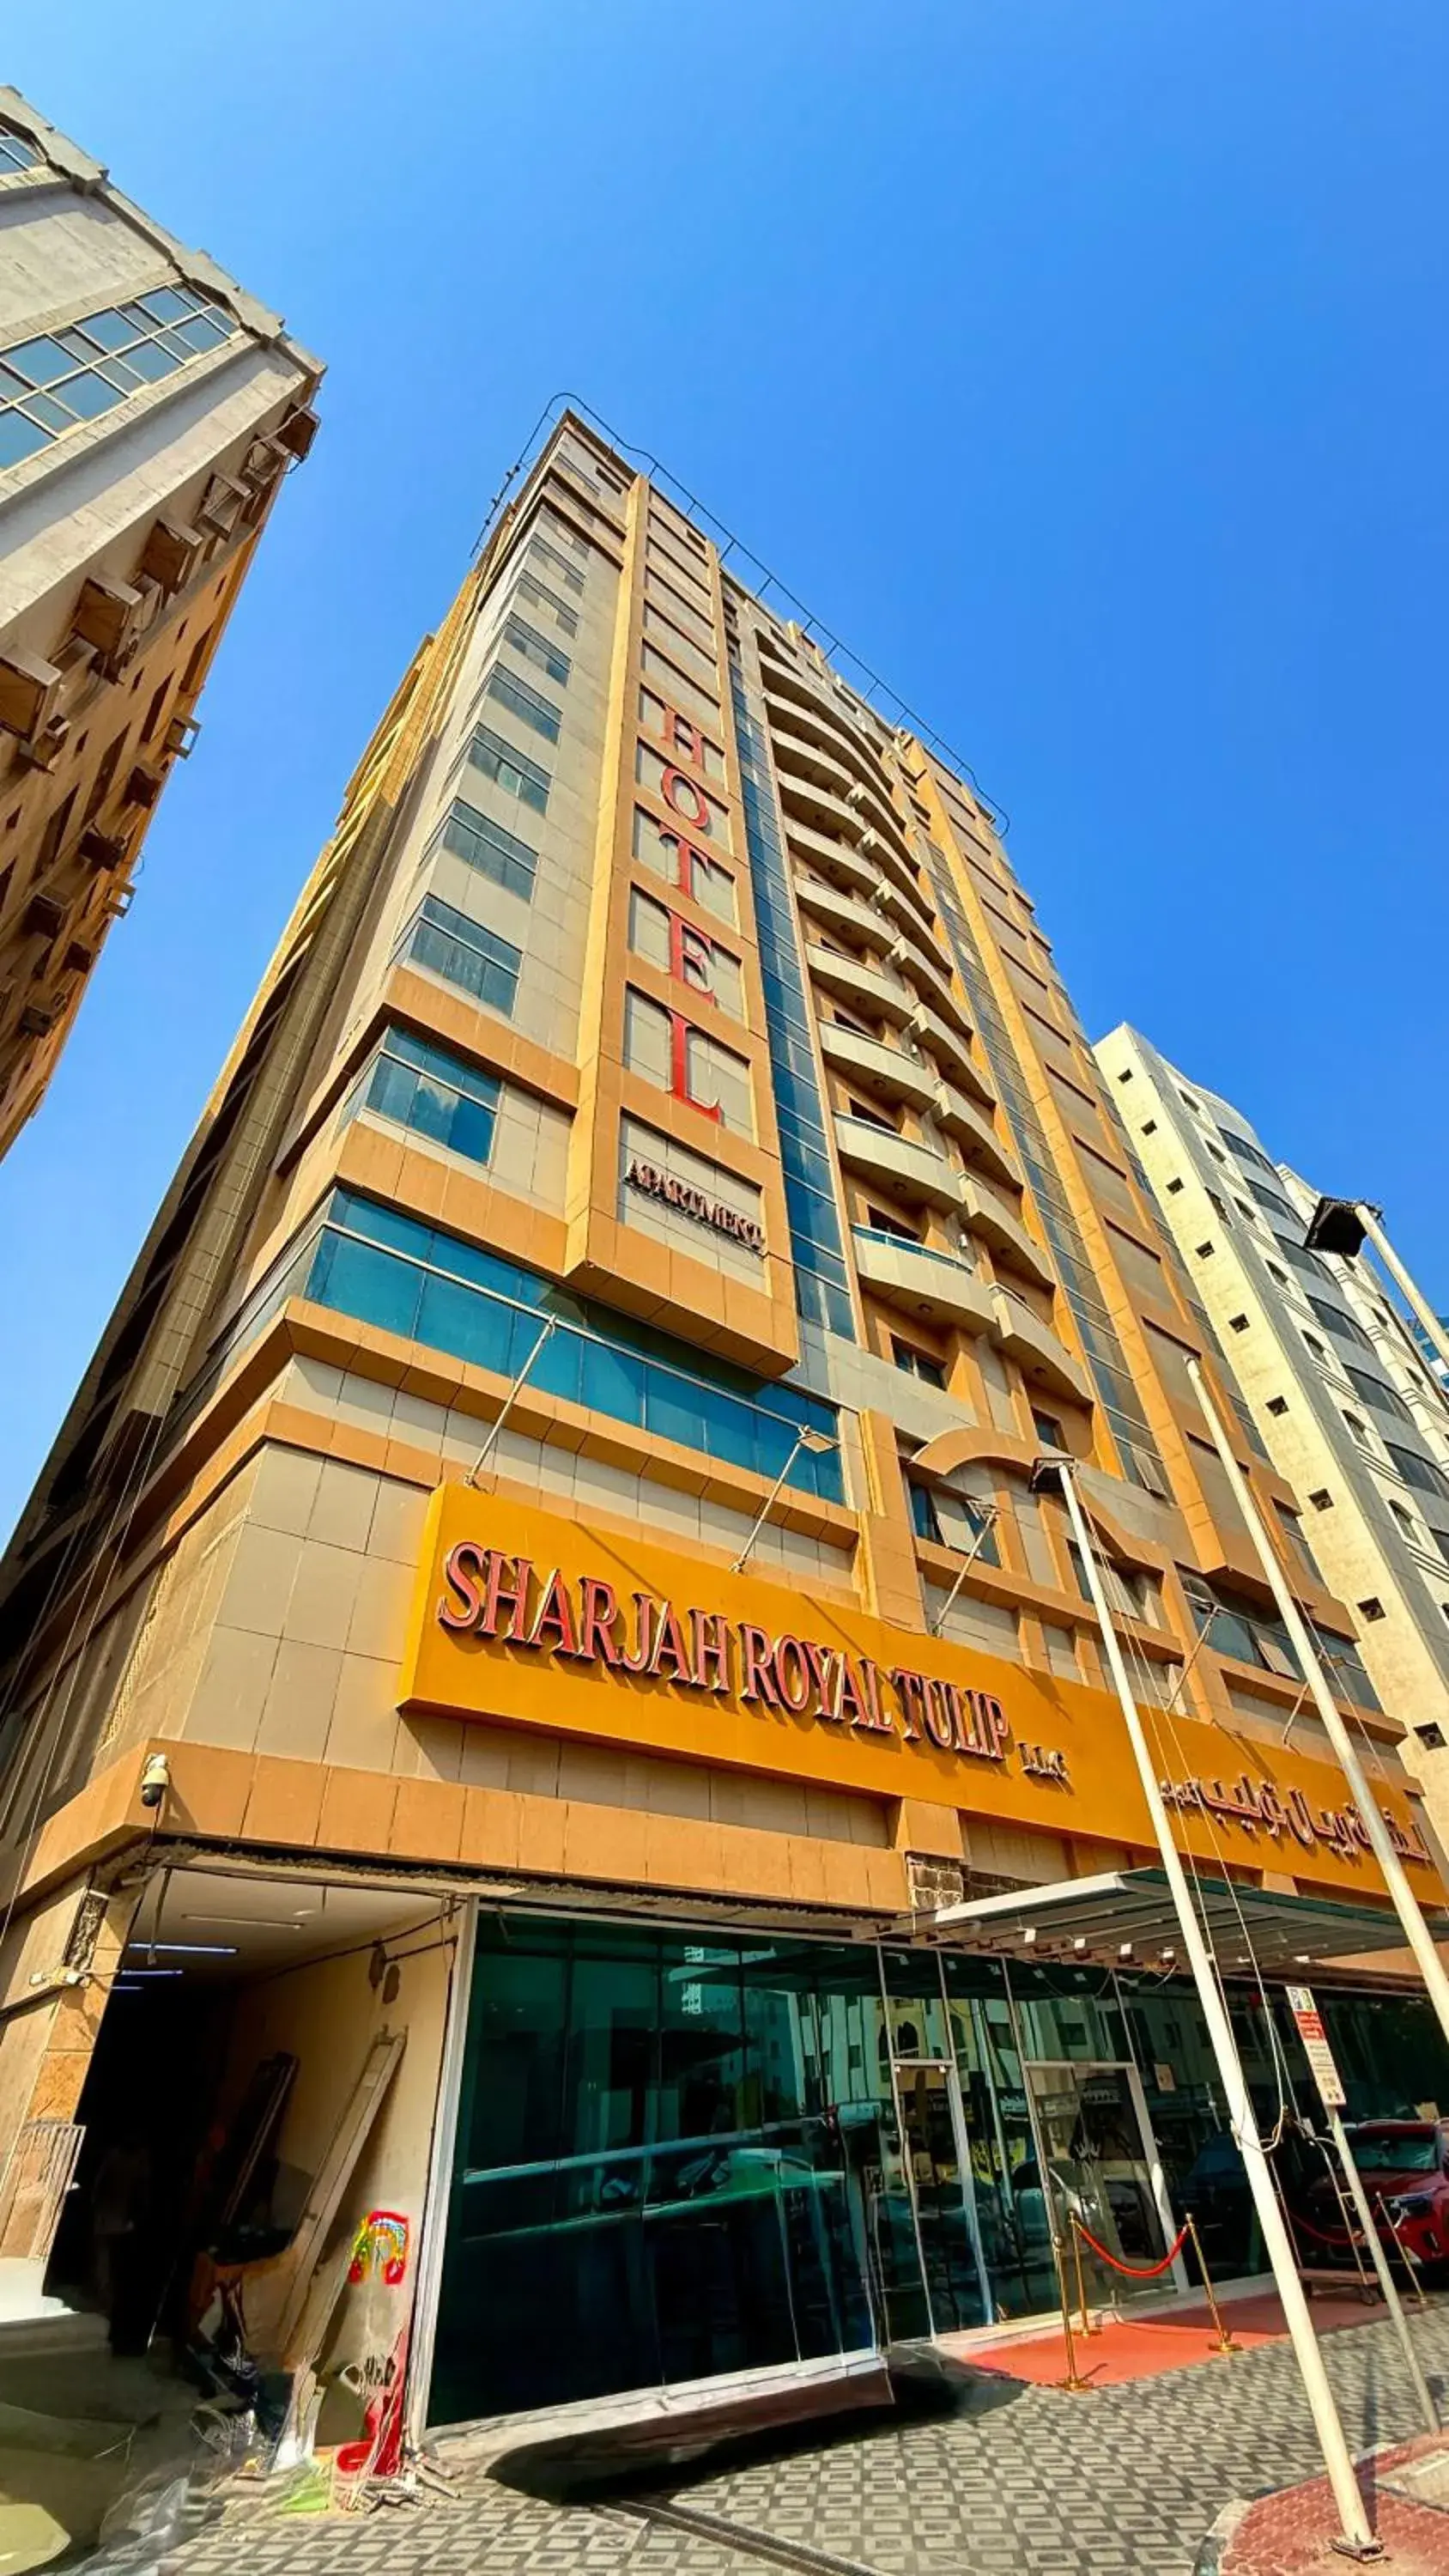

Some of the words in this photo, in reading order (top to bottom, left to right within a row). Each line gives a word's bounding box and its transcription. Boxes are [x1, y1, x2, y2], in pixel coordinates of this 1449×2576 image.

[659, 702, 723, 1125] HOTEL
[622, 1158, 766, 1251] APARTMENT
[438, 1541, 731, 1693] SHARJAH
[737, 1622, 894, 1734] ROYAL
[890, 1668, 1009, 1760] TULIP
[1199, 1772, 1288, 1837] توليب
